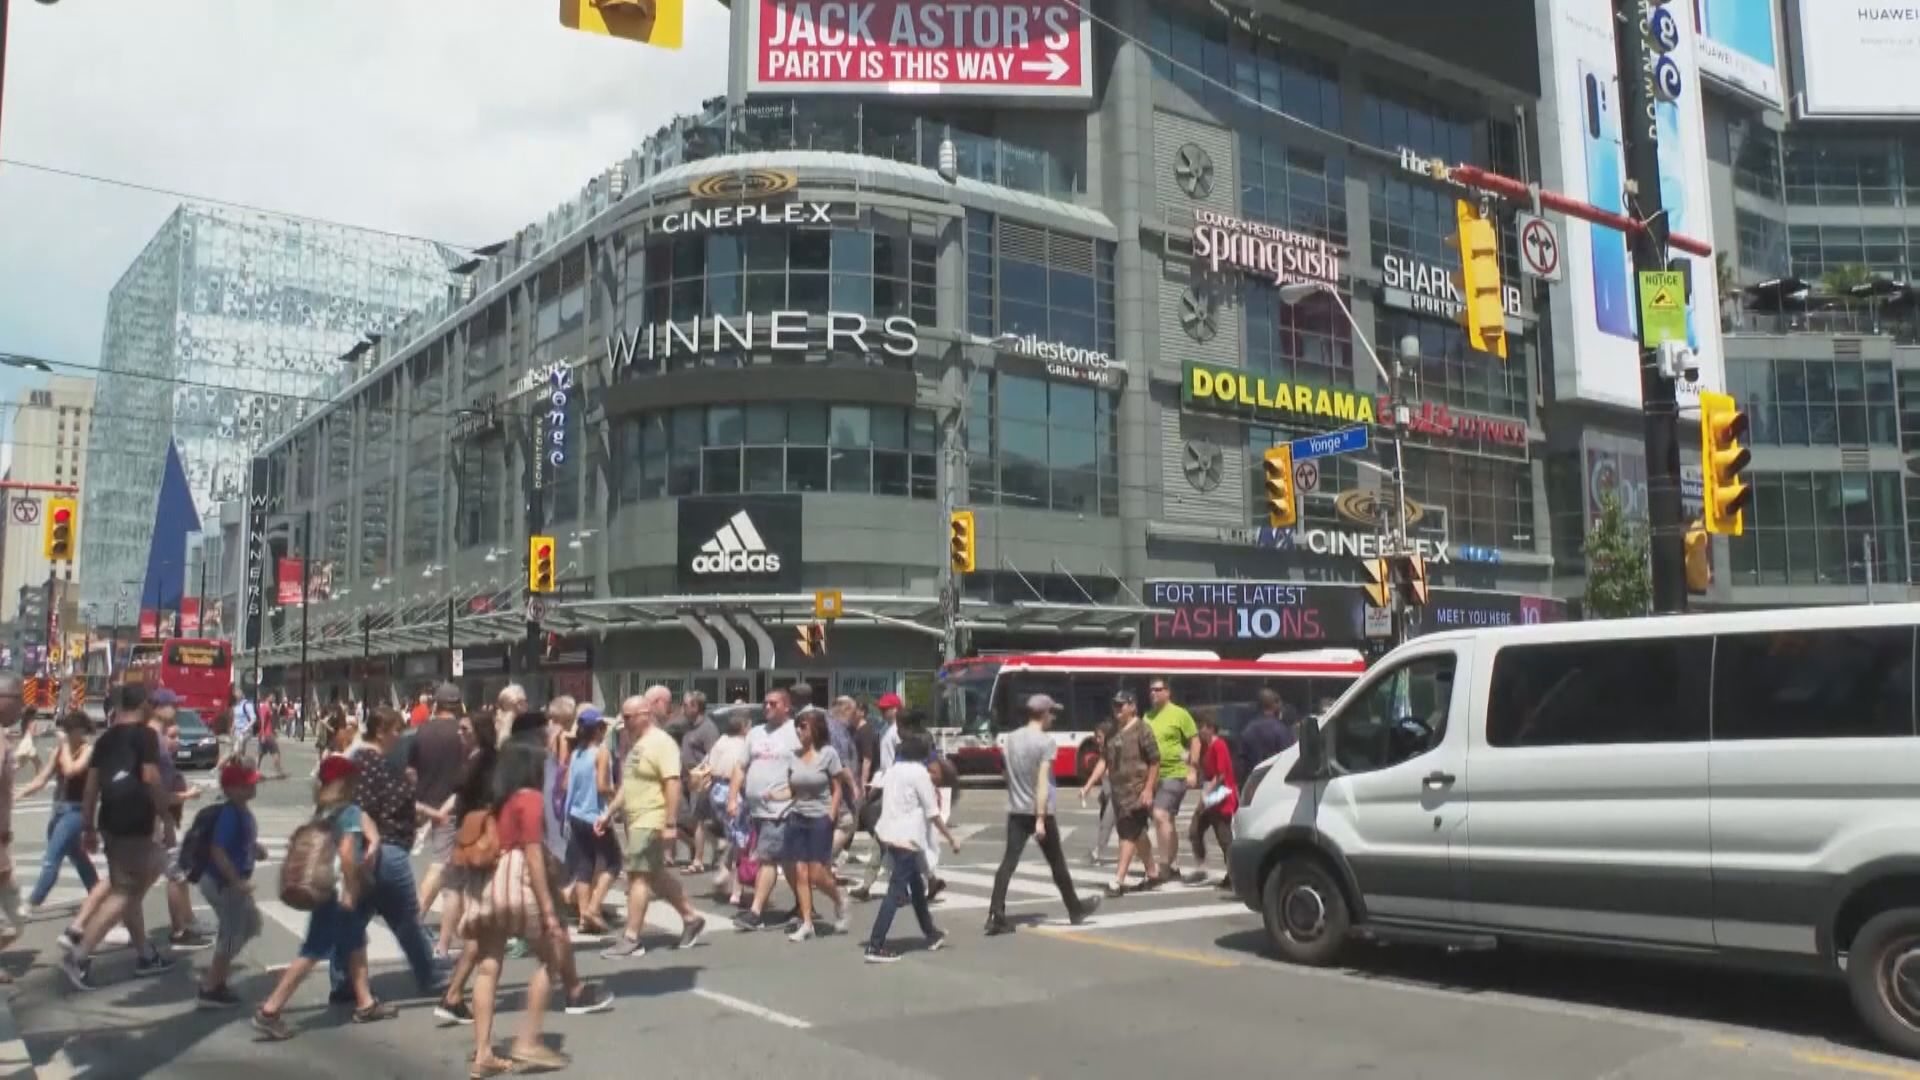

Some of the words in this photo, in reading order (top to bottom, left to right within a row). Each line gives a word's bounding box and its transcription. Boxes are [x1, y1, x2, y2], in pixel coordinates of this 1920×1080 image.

[1857, 8, 1920, 21] HUAWEI
[768, 3, 876, 47] JACK
[888, 4, 1070, 51] ASTOR'S
[768, 50, 852, 79] PARTY
[859, 51, 884, 79] IS
[890, 51, 949, 79] THIS
[956, 52, 1015, 80] WAY
[662, 202, 832, 233] CINEPLEX
[1645, 275, 1679, 286] NOTICE
[1412, 295, 1452, 315] SPORTS
[606, 310, 919, 370] WINNERS
[1047, 363, 1075, 377] GRILL
[1087, 370, 1109, 384] BAR
[1192, 366, 1375, 424] DOLLARAMA
[1309, 436, 1341, 456] Yonge
[248, 495, 267, 615] WINNERS
[692, 549, 781, 573] adidas
[1155, 584, 1194, 604] FOR
[1199, 584, 1238, 604] THE
[1243, 585, 1307, 605] LATEST
[1436, 608, 1465, 624] MEET
[1468, 610, 1487, 625] YOU
